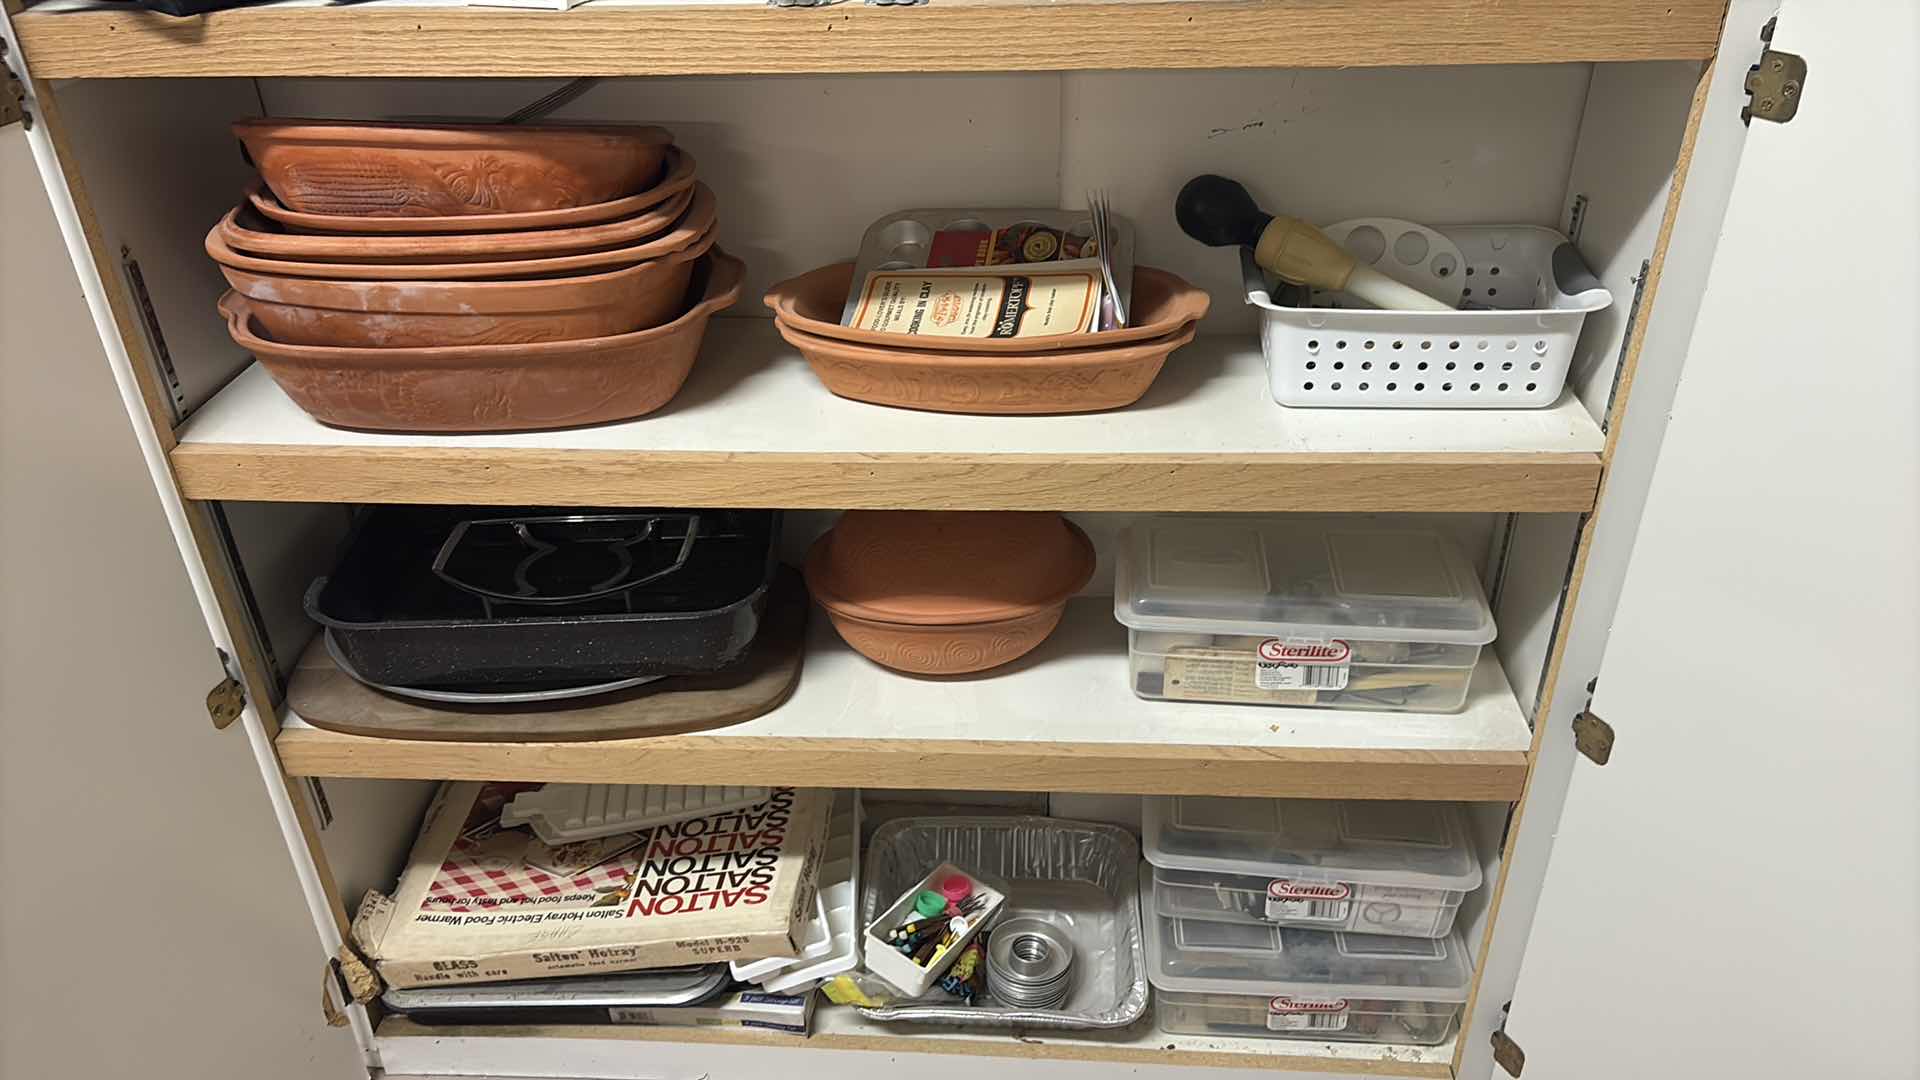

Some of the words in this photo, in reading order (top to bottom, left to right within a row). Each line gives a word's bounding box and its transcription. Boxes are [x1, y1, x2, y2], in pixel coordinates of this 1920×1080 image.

[920, 281, 933, 298] CLAY
[1269, 643, 1338, 657] Sterilite
[654, 809, 790, 840] SALTON
[648, 827, 785, 858] SALTON
[641, 846, 781, 877] SALTON
[634, 866, 776, 897] SALTON
[1279, 883, 1340, 896] Sterilite
[426, 896, 456, 906] hours
[456, 897, 471, 906] for
[472, 896, 498, 906] tasty
[497, 897, 518, 905] and
[519, 896, 537, 905] hot
[537, 895, 561, 904] food
[564, 893, 596, 902] Keeps
[626, 884, 770, 917] SALTON
[415, 914, 462, 925] Warmer
[497, 914, 544, 925] Electric
[543, 911, 585, 921] Hotray
[585, 909, 625, 919] Salton
[464, 915, 496, 926] Food
[676, 939, 709, 948] Model
[532, 951, 578, 964] Salton
[589, 945, 637, 959] Hotray
[692, 944, 741, 955] SUPERB
[432, 959, 479, 972] GLASS
[456, 970, 479, 979] with
